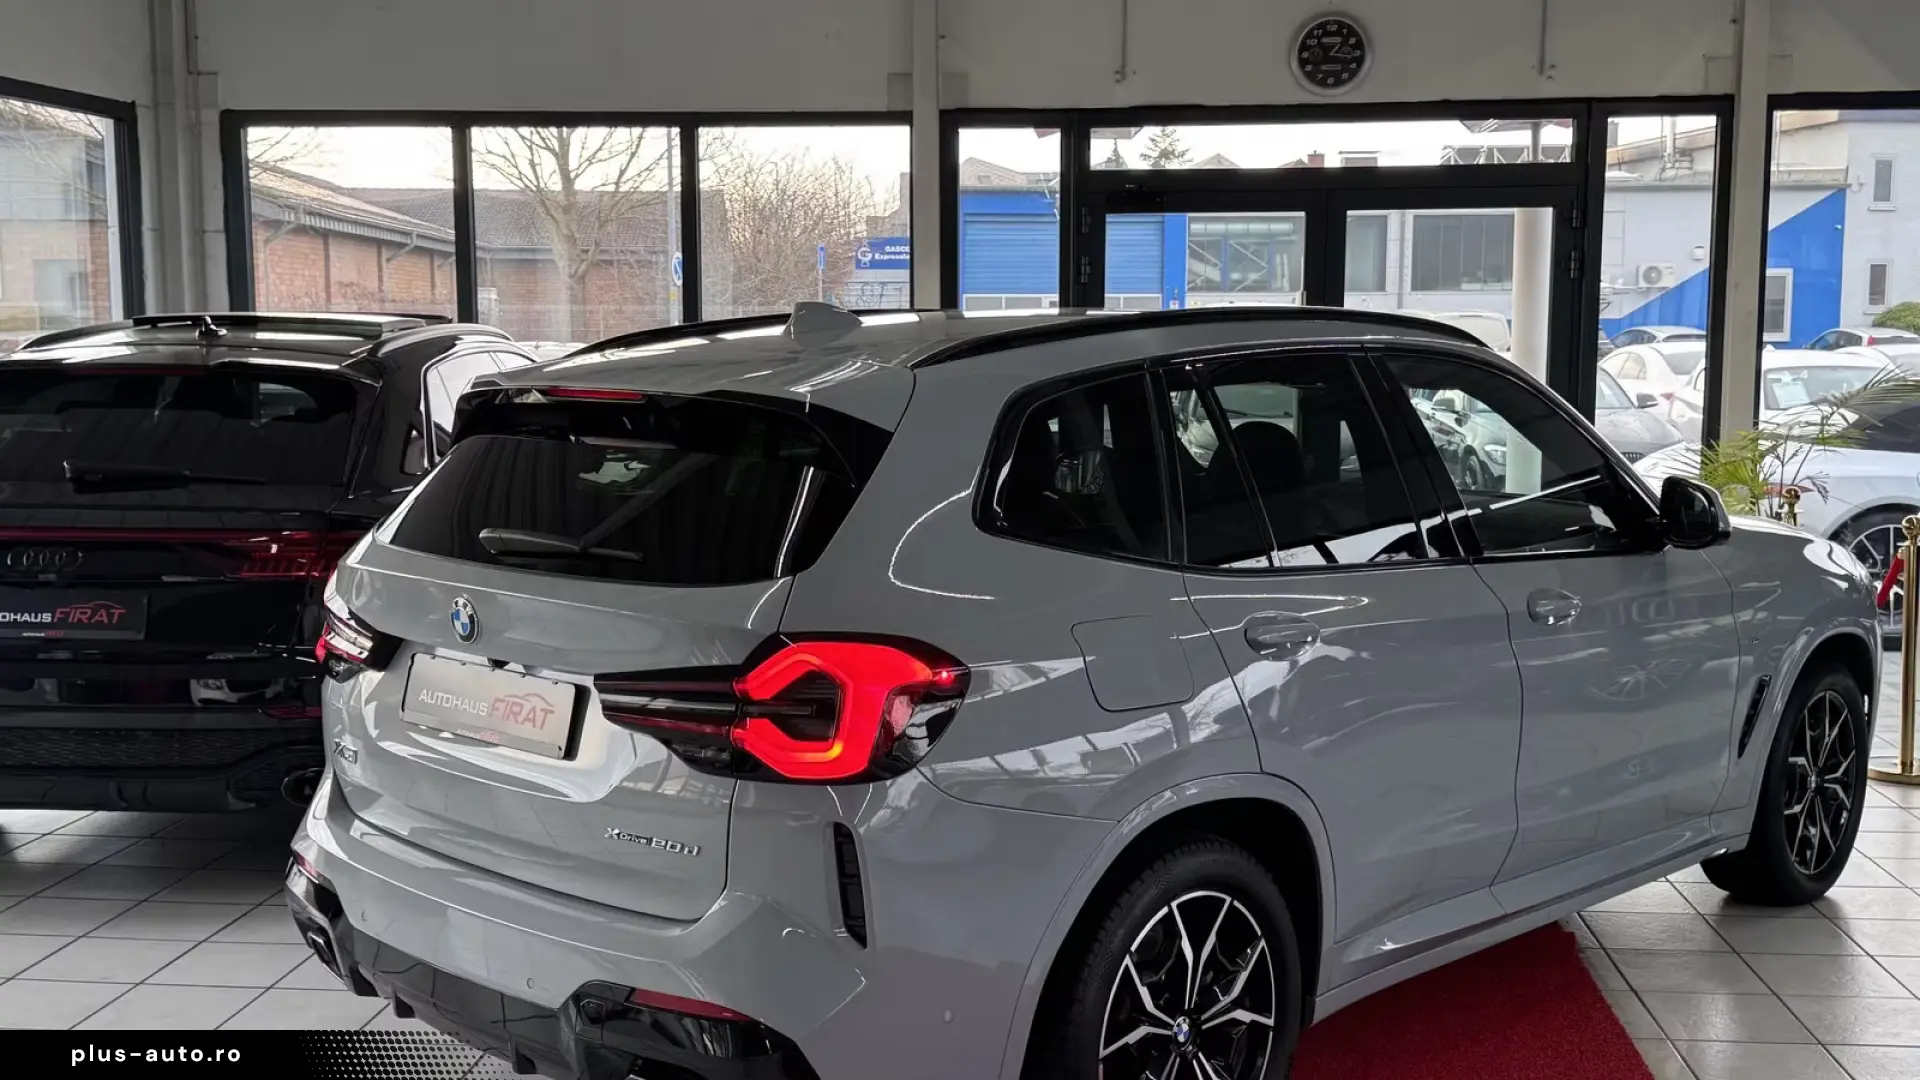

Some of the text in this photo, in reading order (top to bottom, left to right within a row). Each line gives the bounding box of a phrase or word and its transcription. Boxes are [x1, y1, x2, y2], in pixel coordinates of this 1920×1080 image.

[53, 608, 126, 624] FIRAT
[418, 688, 555, 731] AUTOHAUS FIRAT
